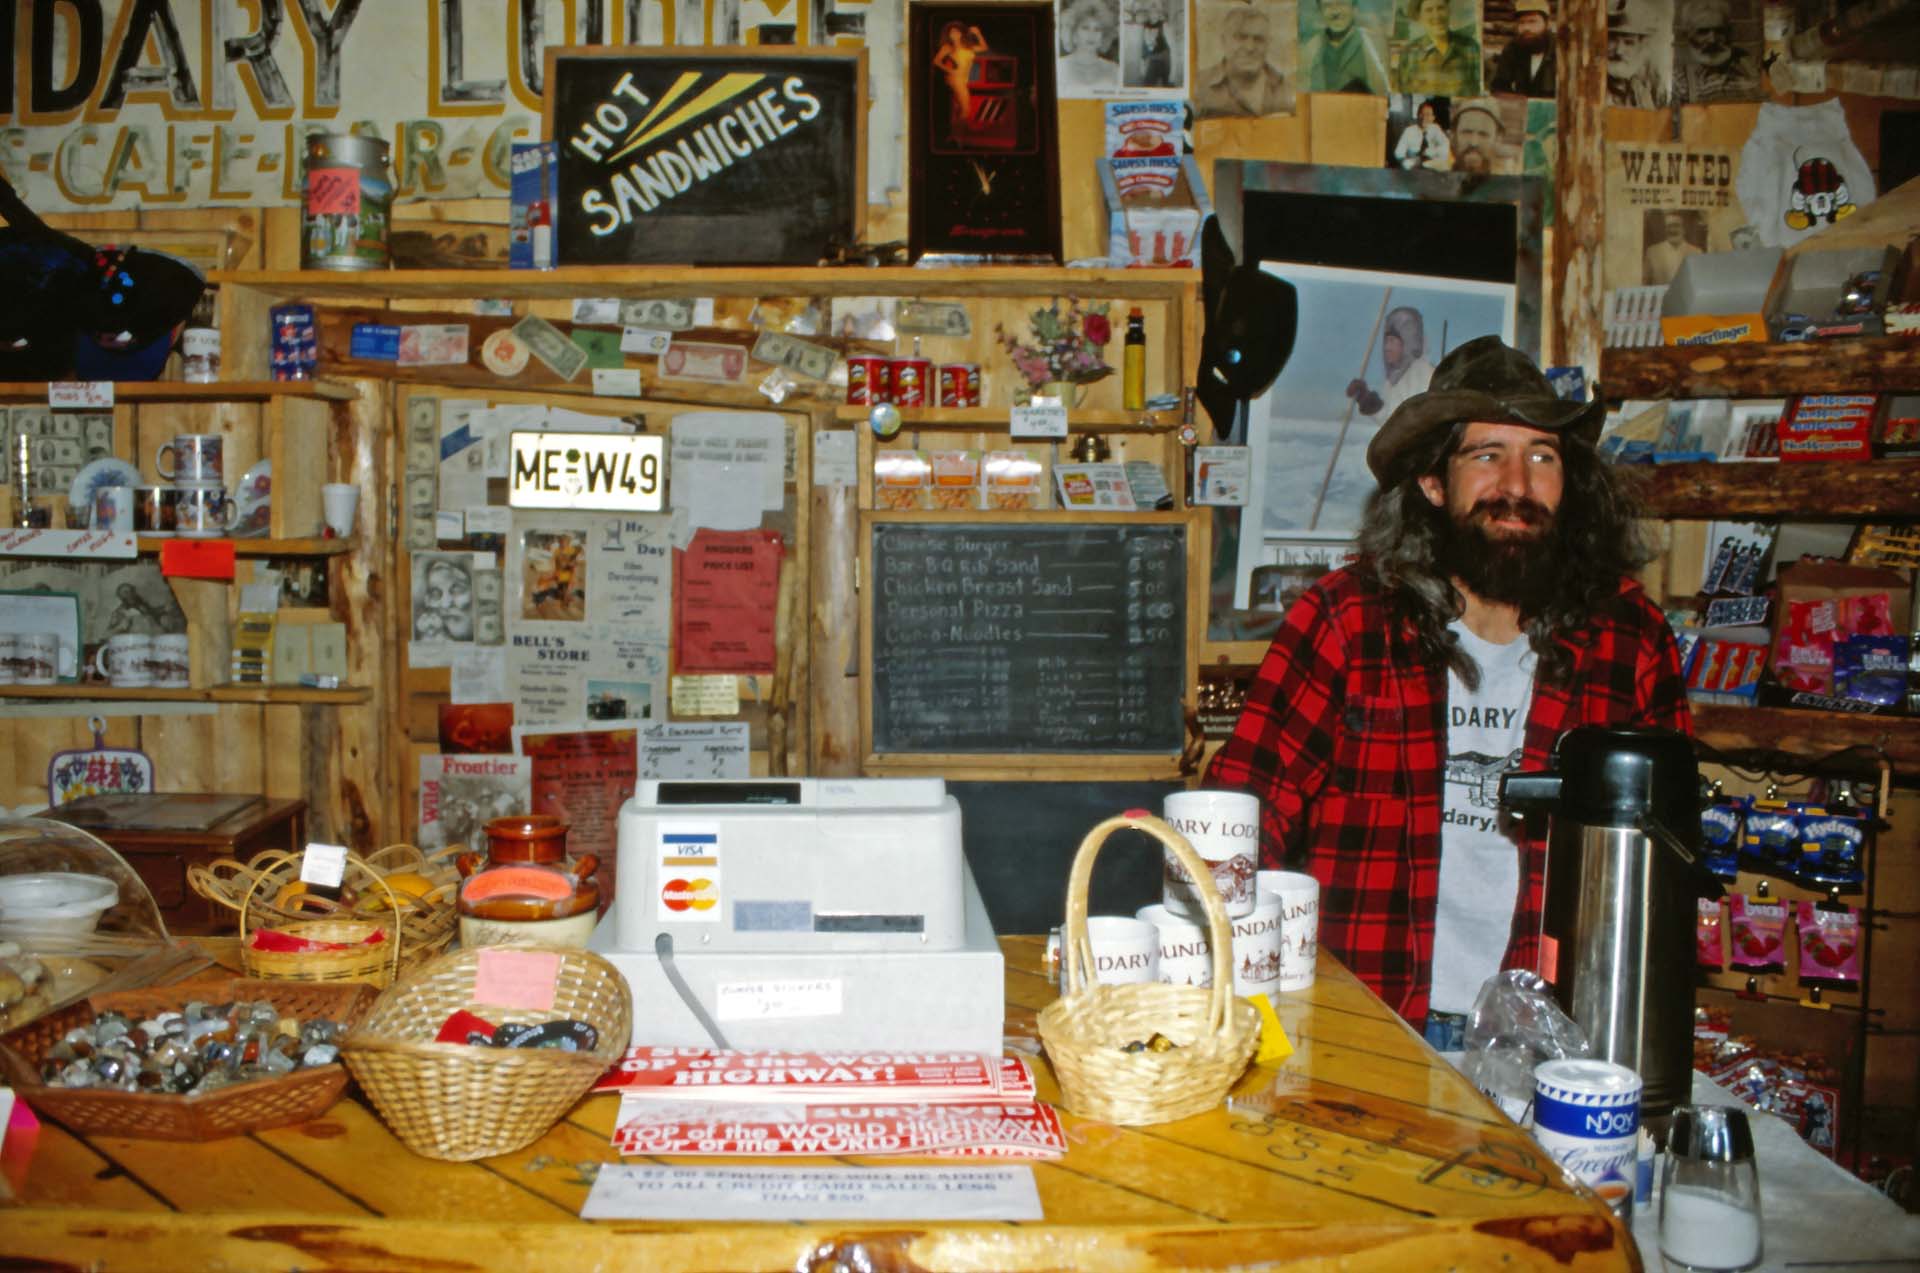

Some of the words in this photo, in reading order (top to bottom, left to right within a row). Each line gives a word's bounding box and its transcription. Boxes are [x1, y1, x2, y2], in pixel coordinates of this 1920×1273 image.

[571, 72, 650, 162] HOT
[582, 76, 822, 237] SANDWICHES
[1621, 151, 1731, 186] WANTED
[637, 544, 666, 557] Day
[954, 536, 1010, 560] Burger
[1272, 547, 1298, 565] The
[1303, 547, 1332, 565] Sale
[995, 553, 1040, 575] Sand
[883, 576, 958, 596] Chicken
[962, 576, 1024, 595] Breast
[1031, 575, 1073, 596] Sand
[973, 599, 1024, 619] Pizza
[513, 635, 565, 647] BELL'S
[537, 649, 590, 662] STORE
[1451, 706, 1517, 729] DARY
[442, 757, 518, 776] Frontier
[422, 780, 440, 825] Wild
[1220, 822, 1259, 839] LOD
[1803, 819, 1864, 845] Hydrox
[678, 844, 705, 856] VISA
[620, 1058, 678, 1073] OP
[688, 1056, 730, 1069] of
[743, 1056, 809, 1069] the
[818, 1053, 978, 1066] WORLD
[673, 1066, 897, 1086] HIGHWAY!
[812, 1105, 1037, 1119] SURVIVED
[621, 1126, 681, 1141] TOP
[687, 1124, 719, 1140] of
[725, 1123, 769, 1140] the
[777, 1122, 887, 1139] WORLD
[910, 1130, 1060, 1149] HIGHWAY!
[671, 1181, 706, 1190] ALL
[716, 1181, 797, 1191] CREDIT
[801, 1182, 864, 1192] CARD
[870, 1182, 937, 1192] SALES
